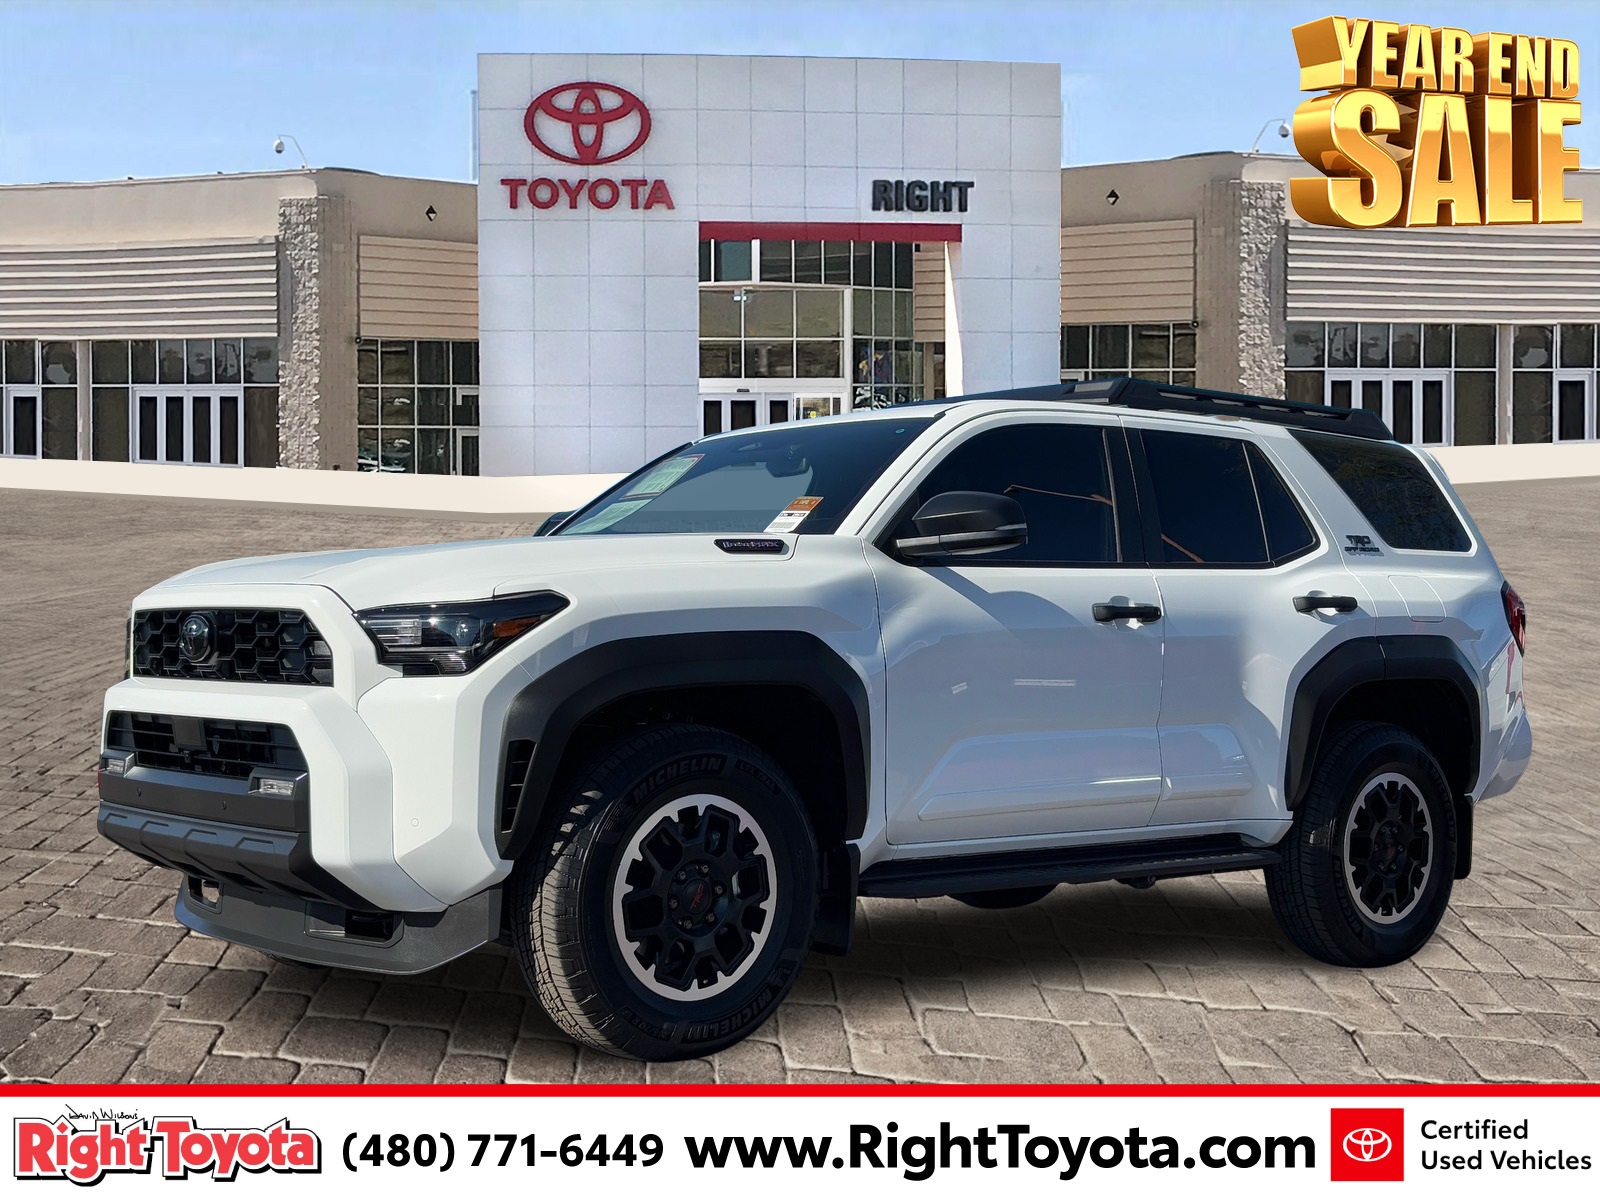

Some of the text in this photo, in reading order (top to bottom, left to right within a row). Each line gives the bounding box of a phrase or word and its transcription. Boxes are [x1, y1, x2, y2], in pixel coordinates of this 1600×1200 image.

[500, 177, 676, 210] TOYOTA
[872, 179, 975, 212] RIGHT
[633, 755, 724, 804] MICHELIN
[686, 987, 774, 1039] MICHELIN
